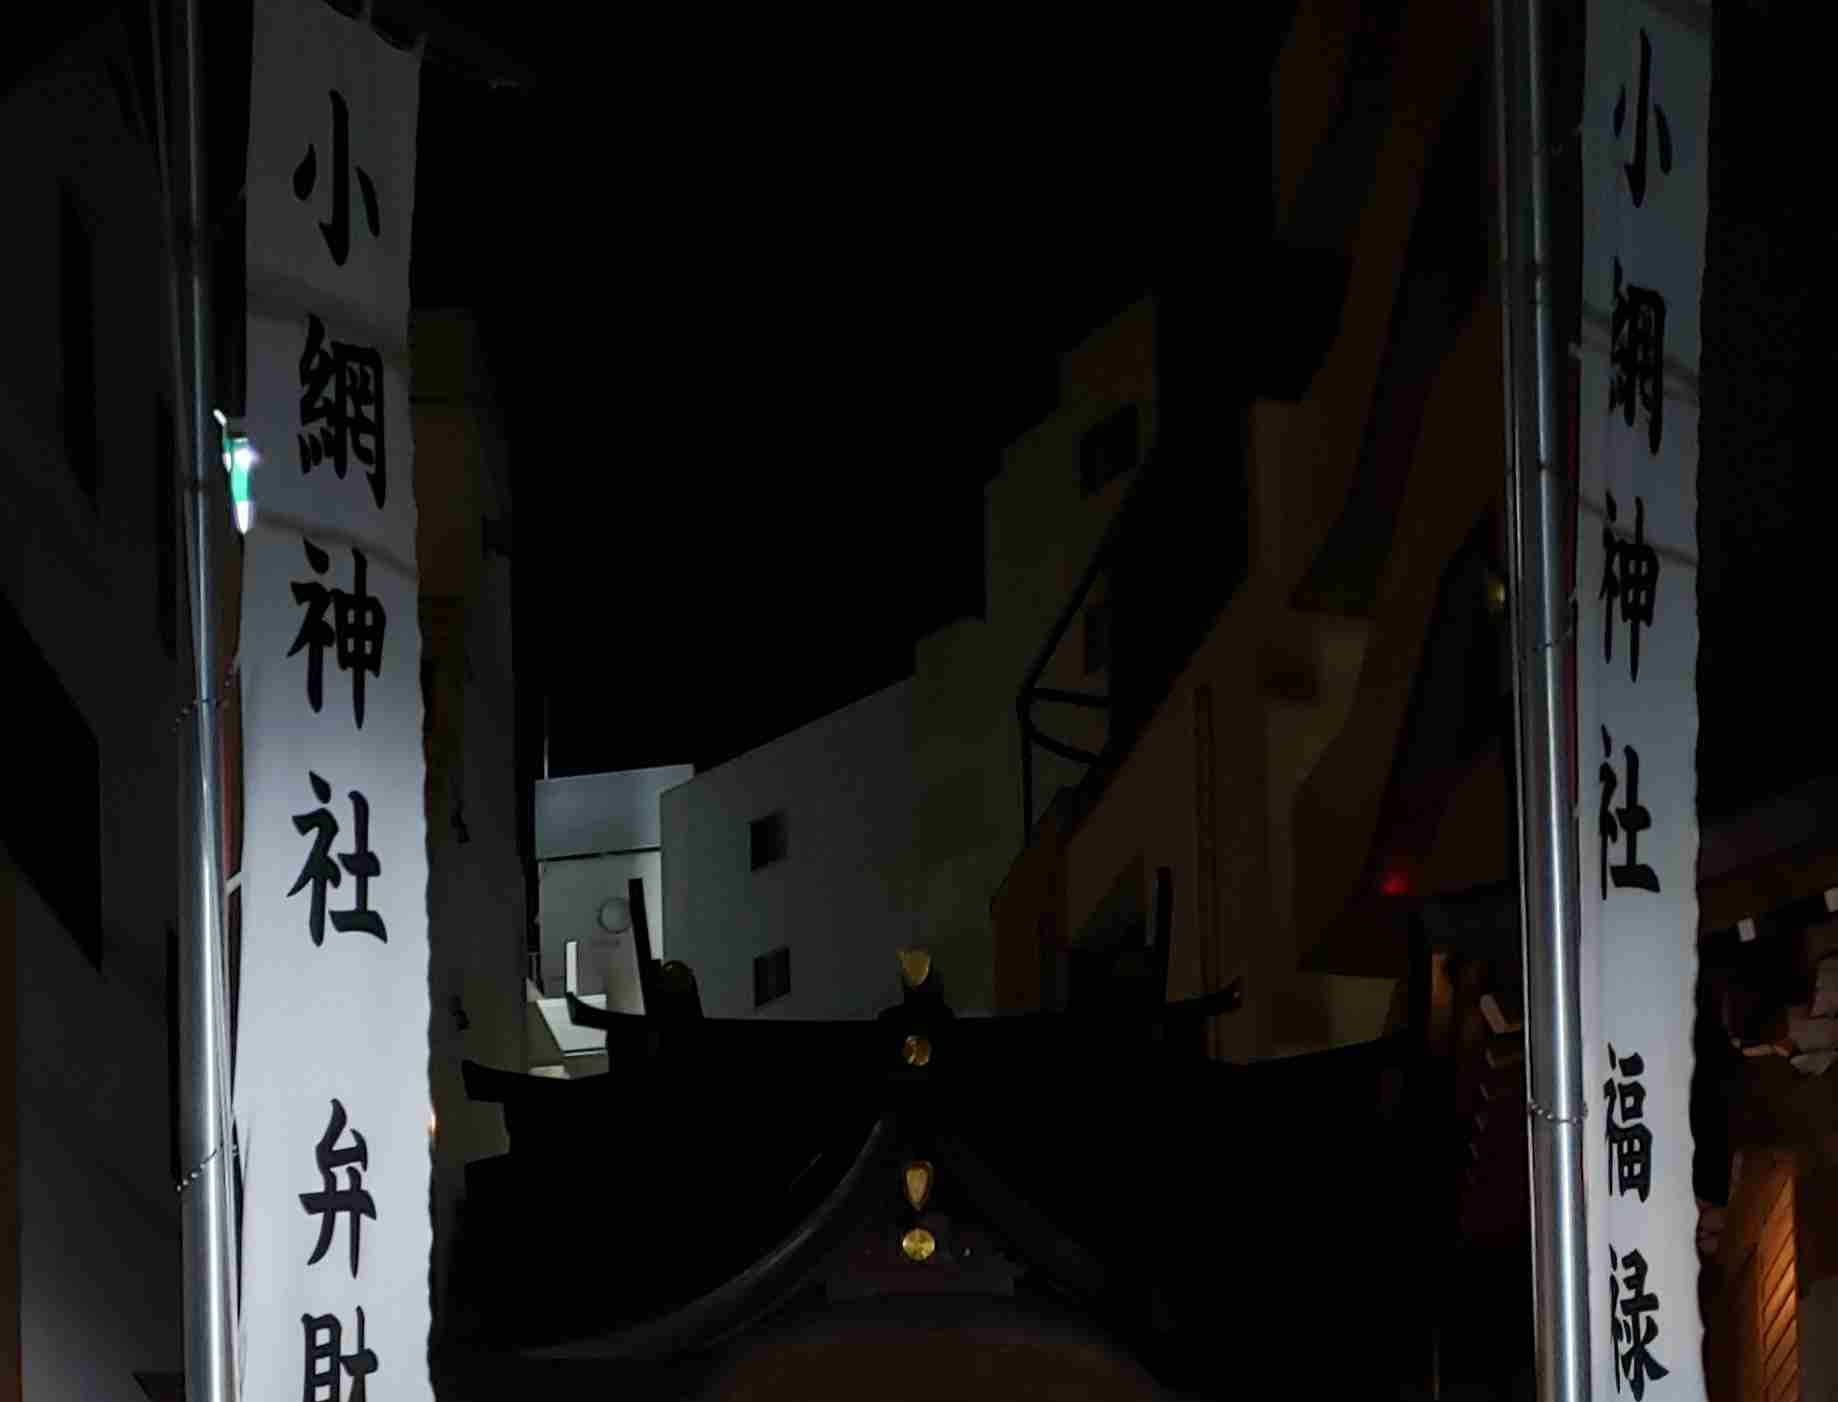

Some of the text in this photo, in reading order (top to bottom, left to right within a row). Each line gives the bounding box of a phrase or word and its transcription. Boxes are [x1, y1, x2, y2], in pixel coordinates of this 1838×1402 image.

[287, 89, 387, 946] 小網神社
[1599, 29, 1672, 900] 小網神社
